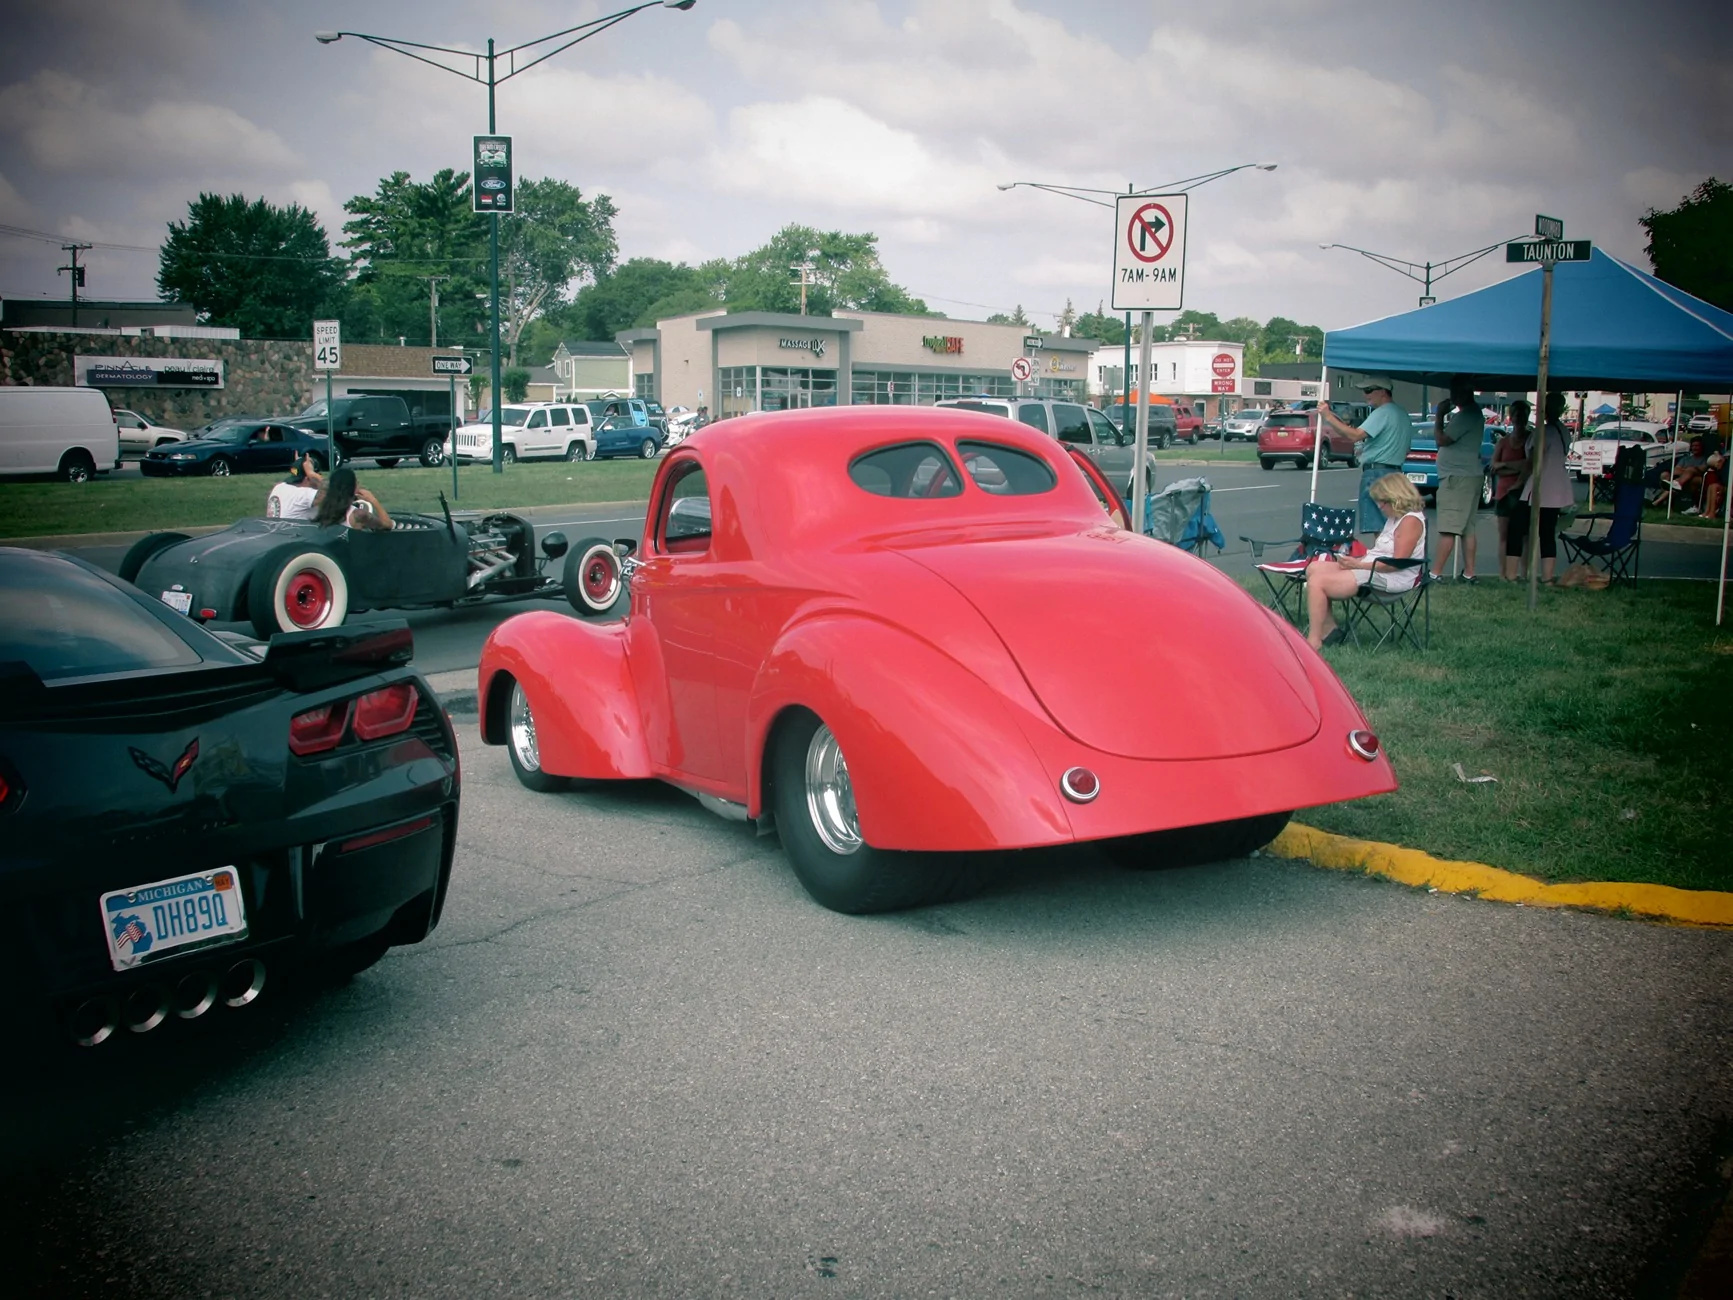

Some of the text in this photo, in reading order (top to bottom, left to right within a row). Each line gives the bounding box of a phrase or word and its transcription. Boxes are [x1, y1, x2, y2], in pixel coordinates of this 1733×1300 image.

[1523, 243, 1575, 260] TAUNTON
[317, 326, 338, 335] SPEED
[319, 337, 335, 345] LIMIT
[779, 339, 810, 349] MASSAGE
[317, 346, 339, 364] 45
[95, 361, 152, 371] PINNACLE
[436, 361, 462, 369] ONE WAY
[137, 879, 203, 903] MICHIGAN
[152, 892, 229, 941] DH89Q
